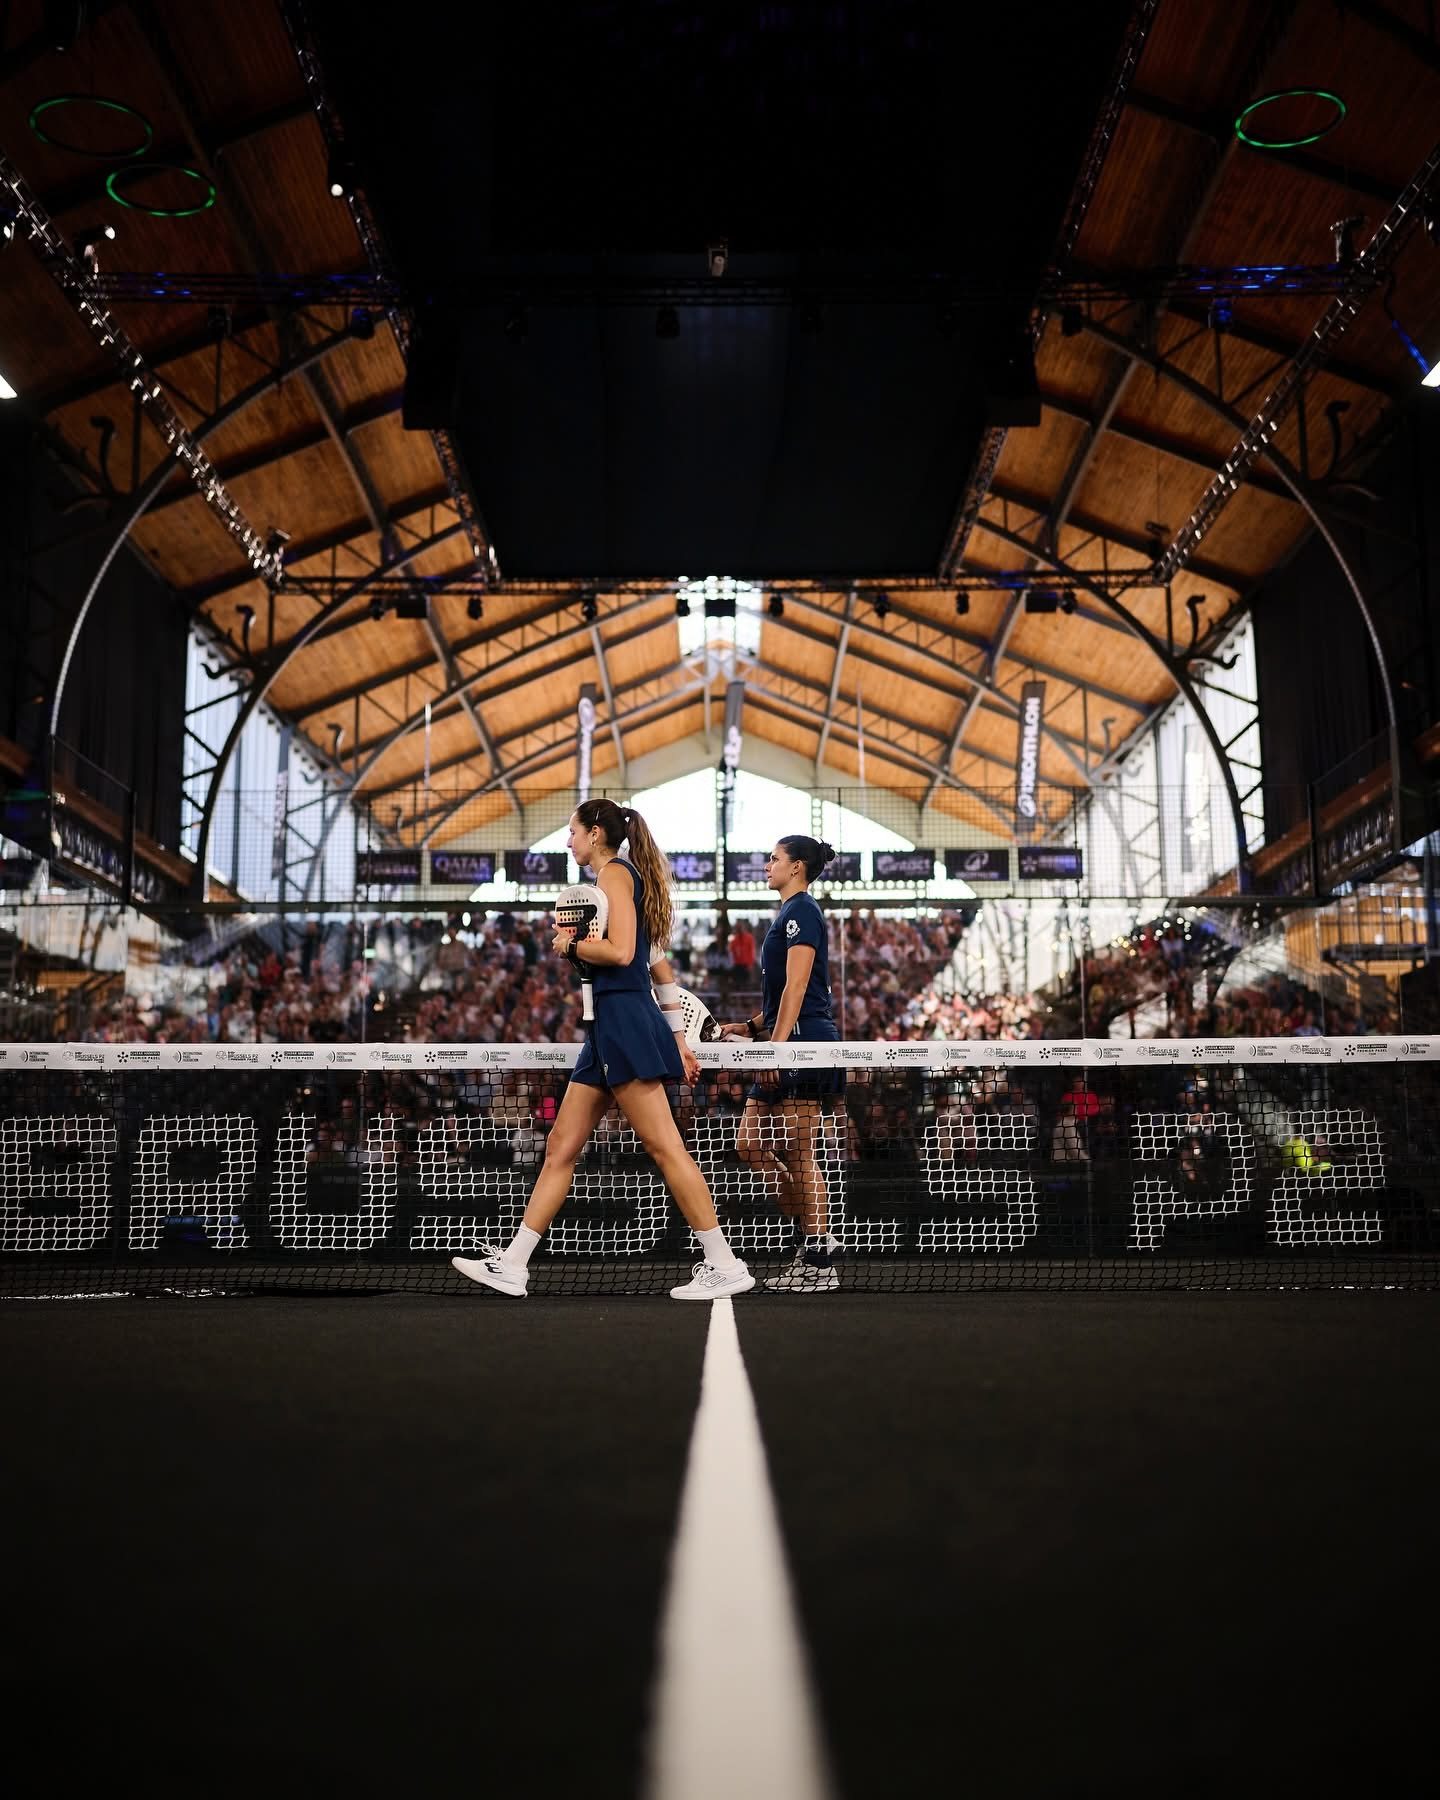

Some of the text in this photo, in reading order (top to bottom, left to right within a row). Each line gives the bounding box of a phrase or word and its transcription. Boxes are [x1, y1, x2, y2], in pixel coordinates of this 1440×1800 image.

[435, 857, 490, 870] QATAR
[0, 1109, 1388, 1257] BRUSSELS P2
